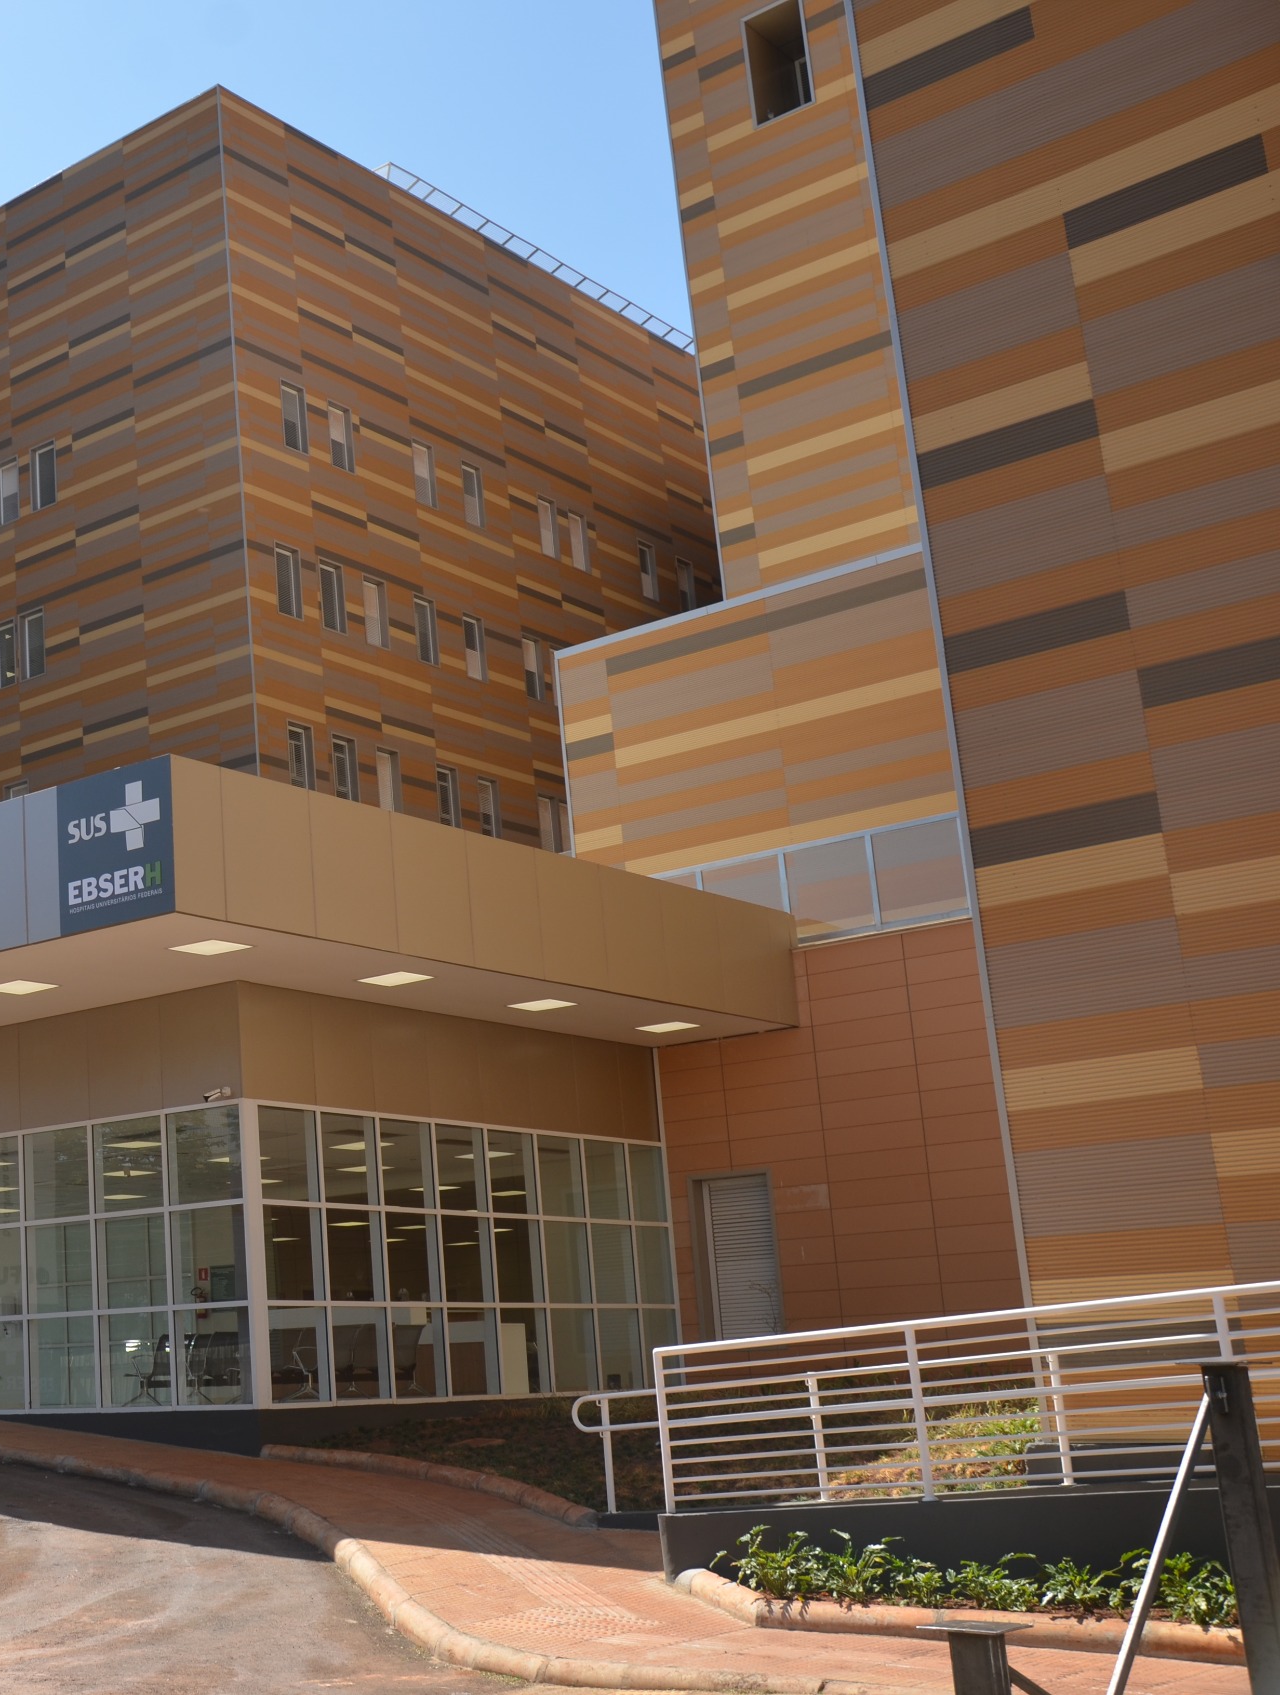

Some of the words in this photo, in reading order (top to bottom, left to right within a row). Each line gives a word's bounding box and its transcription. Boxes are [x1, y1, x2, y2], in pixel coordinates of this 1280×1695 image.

[67, 812, 107, 845] SUS
[68, 860, 163, 906] EBSERH
[69, 903, 96, 914] HOSPITAIS
[95, 893, 137, 909] UNIVERSITÁRIOS
[137, 887, 163, 899] FEDERAIS
